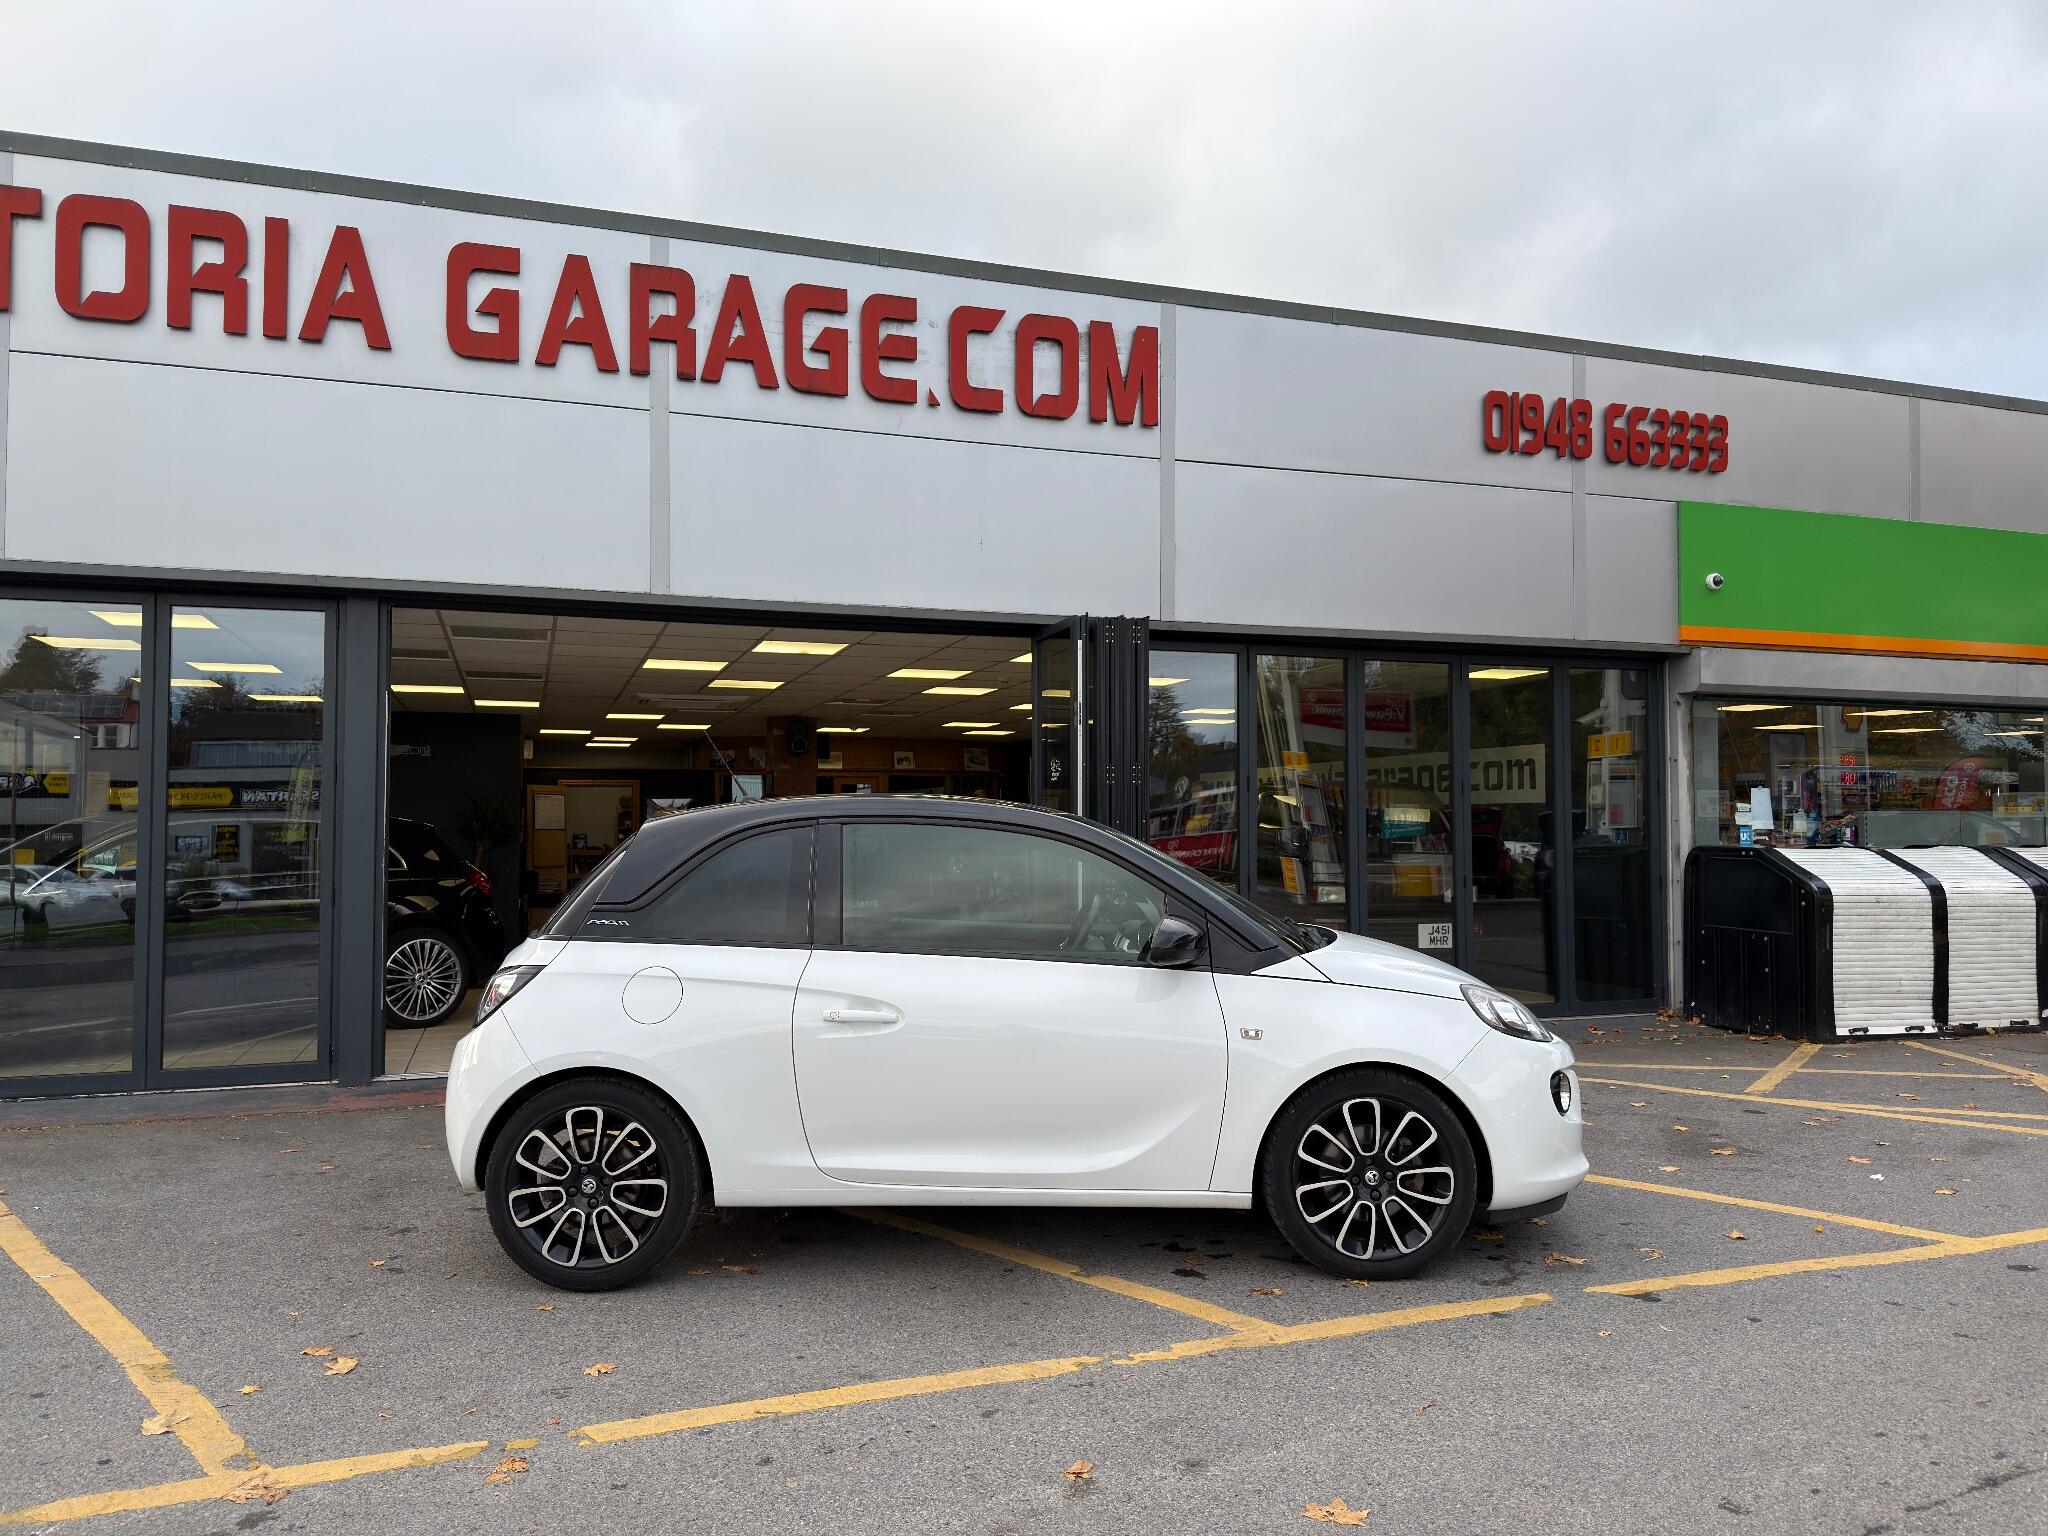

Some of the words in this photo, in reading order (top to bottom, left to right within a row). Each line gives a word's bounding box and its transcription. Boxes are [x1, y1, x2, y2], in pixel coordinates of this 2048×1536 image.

[446, 241, 1159, 428] GARAGE.COM
[1484, 389, 1593, 459] 01948
[1605, 402, 1729, 473] 663333
[1428, 925, 1450, 936] J451
[1429, 935, 1449, 946] MHR
